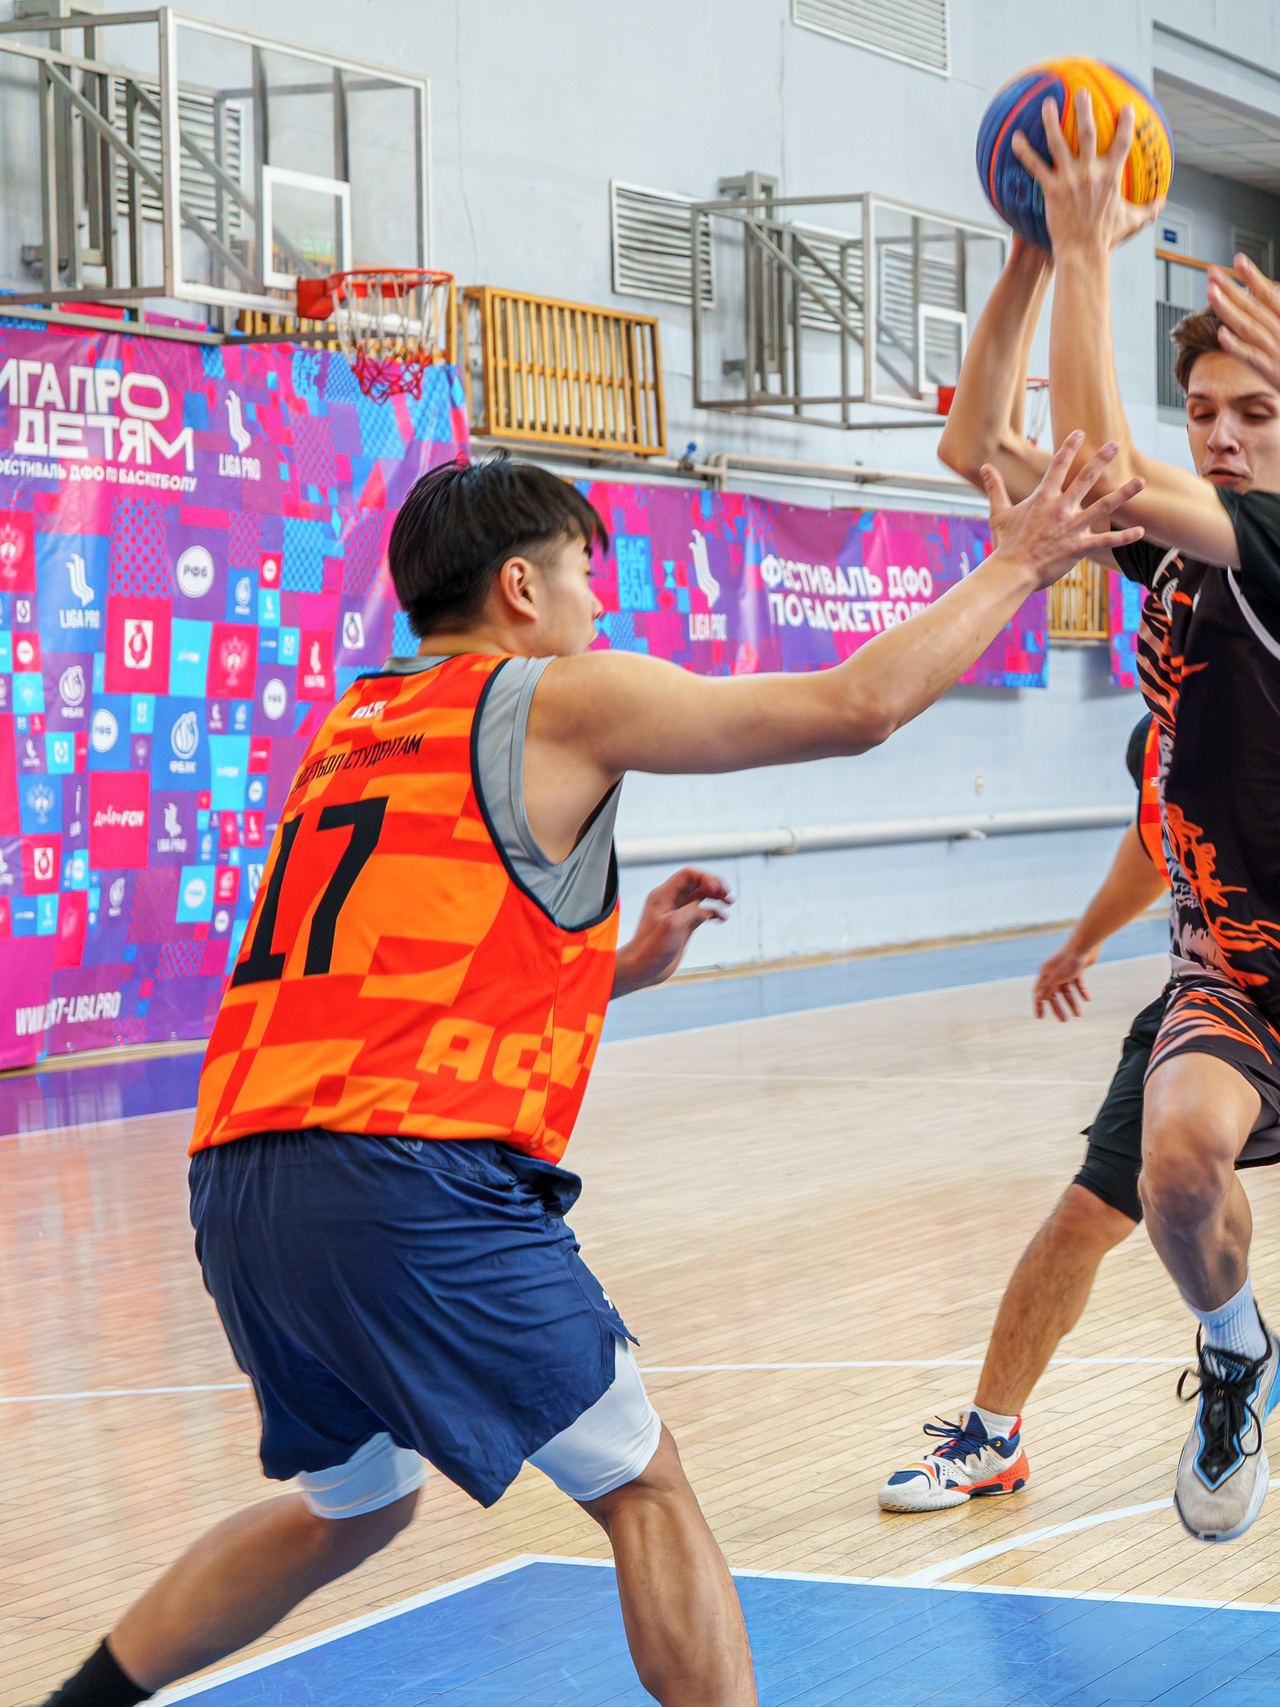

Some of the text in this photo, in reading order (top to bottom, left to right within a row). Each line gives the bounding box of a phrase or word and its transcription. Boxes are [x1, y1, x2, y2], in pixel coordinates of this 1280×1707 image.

[13, 407, 195, 472] ДЕТЯМ
[69, 464, 105, 482] ДФО
[118, 467, 198, 493] БАСКЕТБОЛУ
[218, 452, 261, 481] LIGA PRO
[615, 537, 645, 561] БАС
[182, 563, 210, 580] РФБ
[618, 560, 646, 585] КЕТ
[760, 553, 933, 598] ФЕСТИВАЛЬ ДФО
[619, 583, 653, 611] БОЛ
[58, 607, 101, 629] LIGA PRO
[689, 613, 713, 642] LIGA
[802, 596, 931, 633] БАСКЕТБОЛ
[342, 732, 426, 771] СТУДЕНТАМ
[170, 838, 187, 852] PRO
[230, 795, 390, 990] 17
